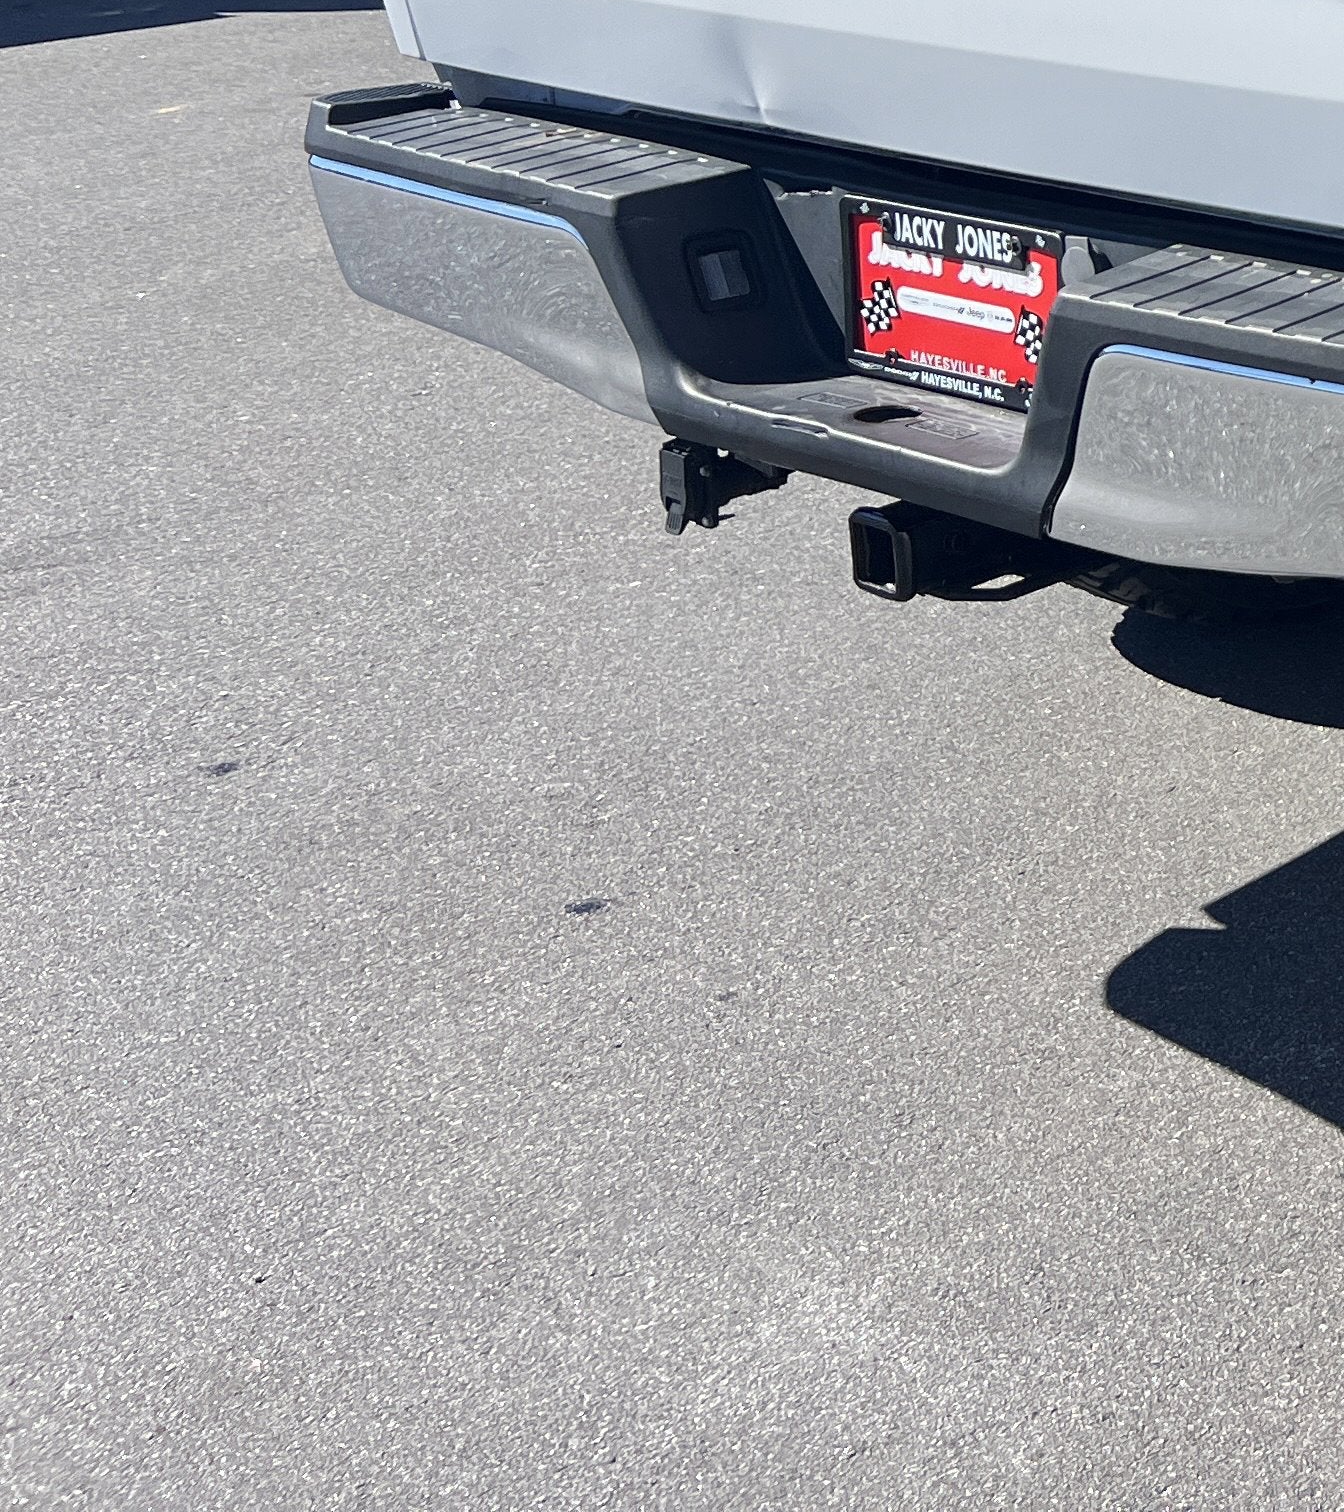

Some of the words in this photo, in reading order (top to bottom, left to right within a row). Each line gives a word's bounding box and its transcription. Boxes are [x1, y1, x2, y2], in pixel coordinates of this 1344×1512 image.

[893, 212, 946, 250] JACKY
[955, 224, 1013, 264] JONES
[920, 370, 983, 399] HAYESVILLE,
[984, 384, 1006, 402] N.C.
